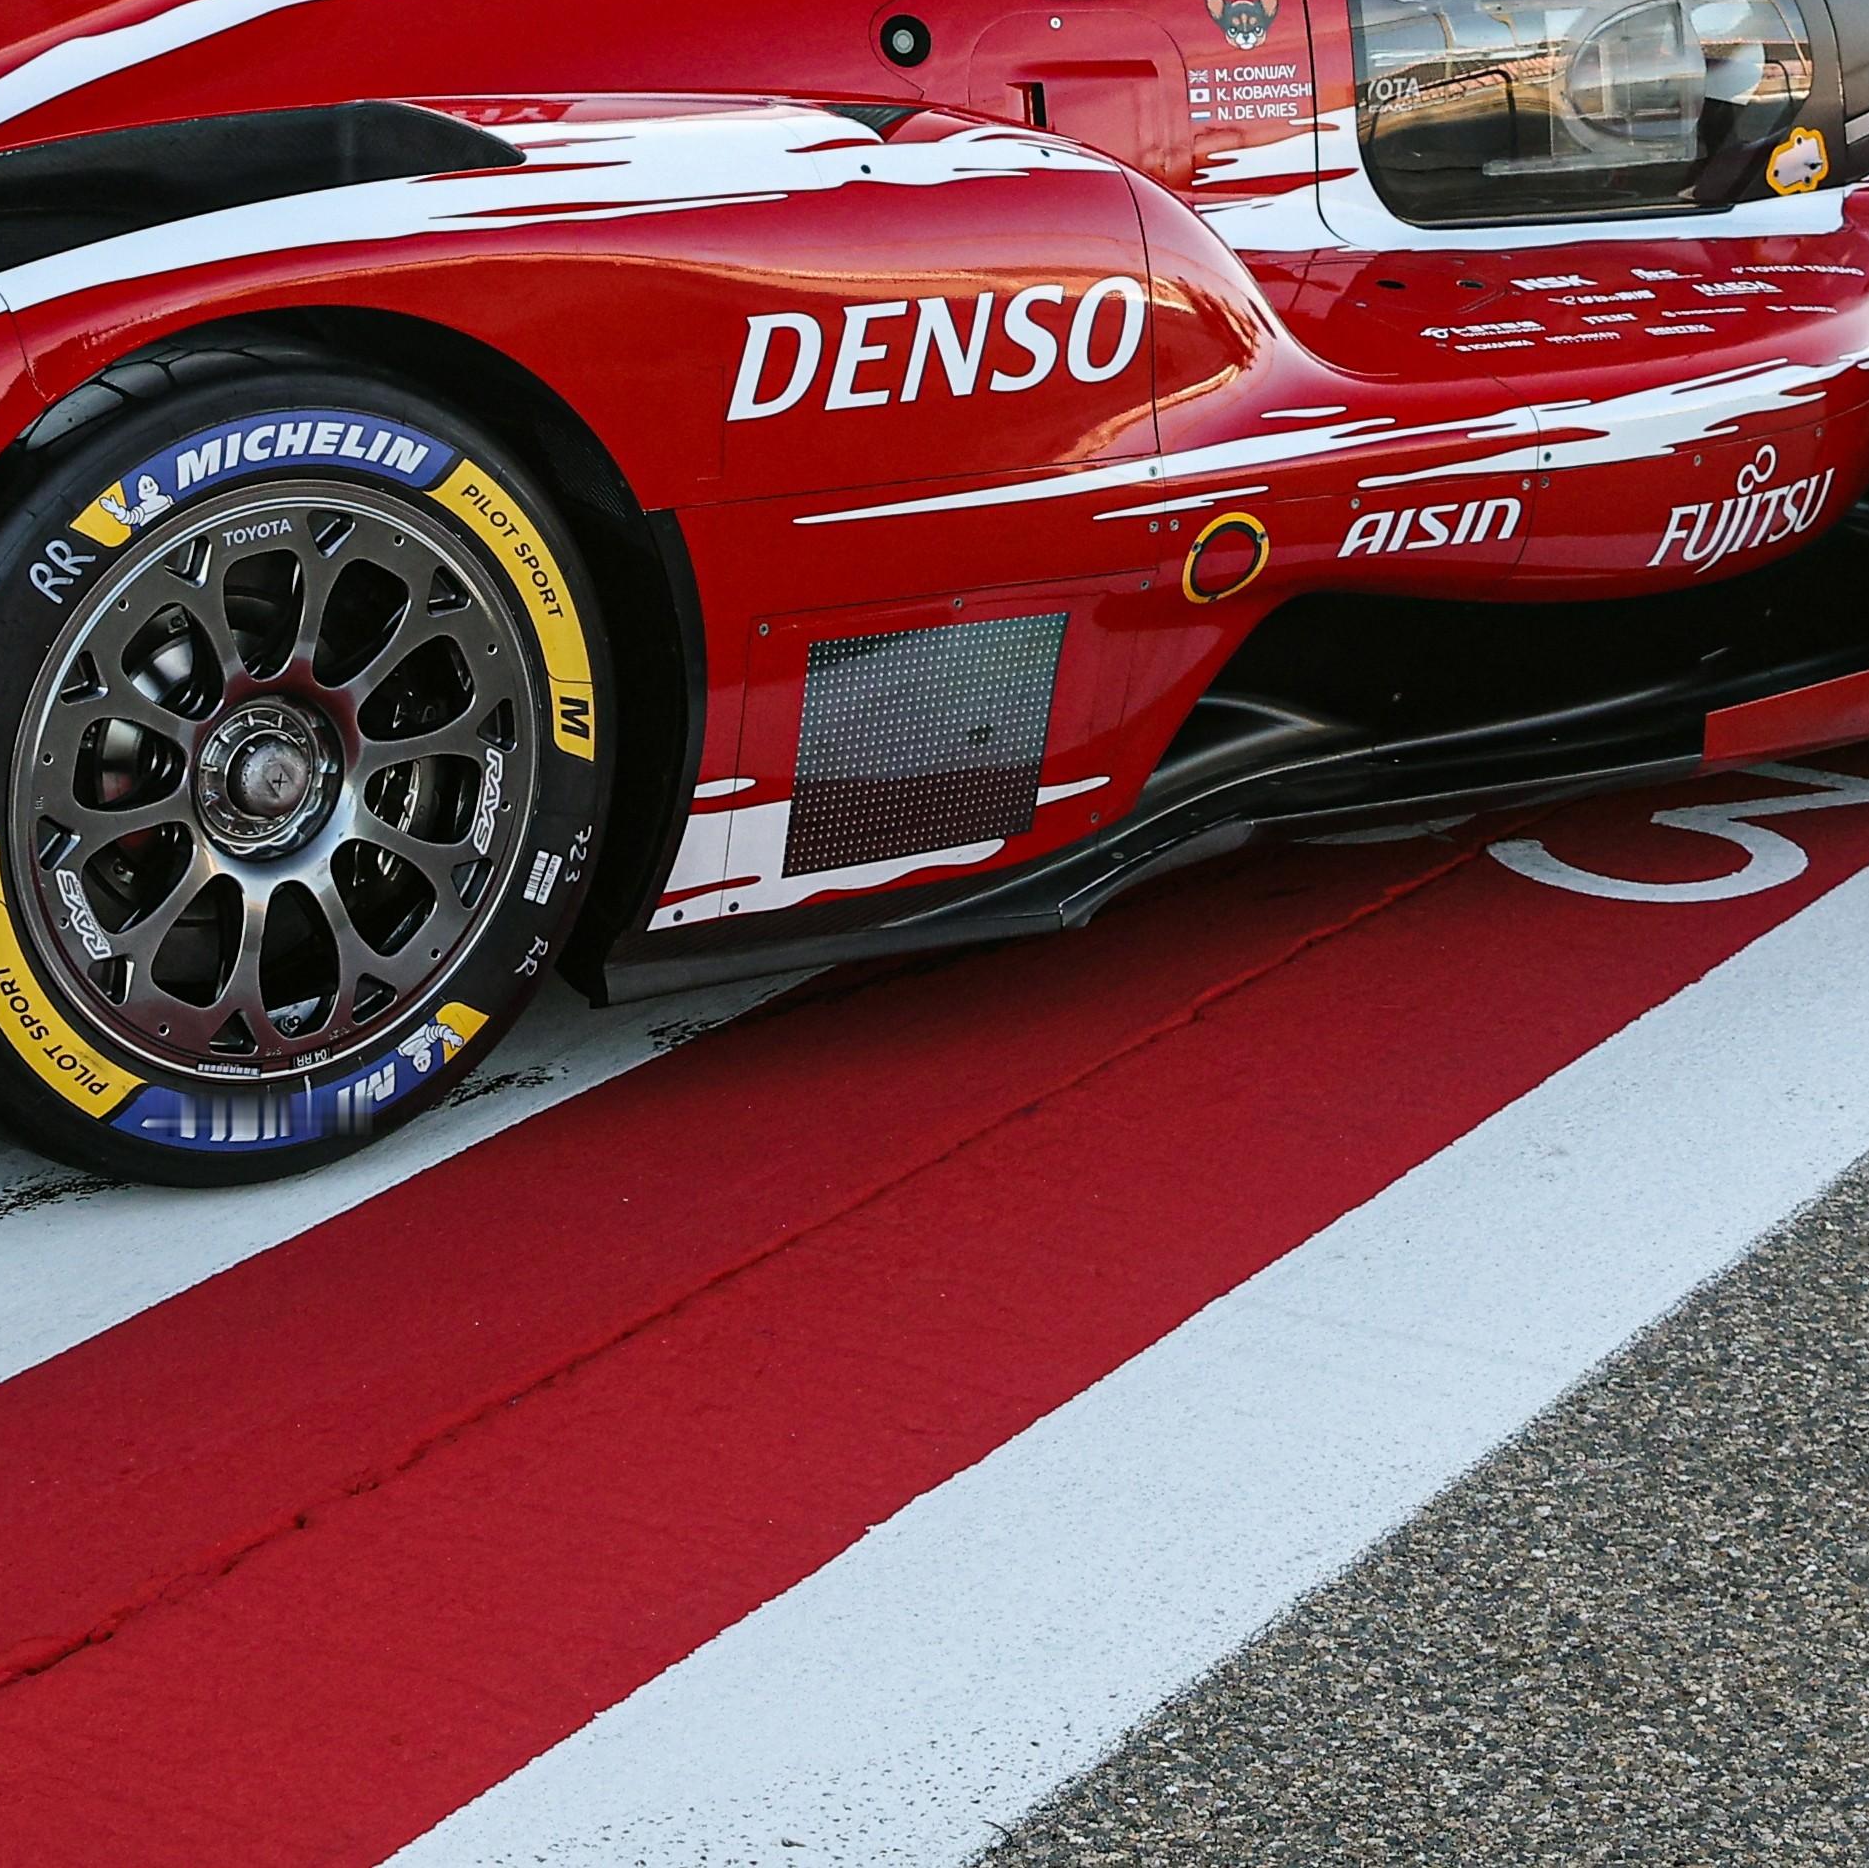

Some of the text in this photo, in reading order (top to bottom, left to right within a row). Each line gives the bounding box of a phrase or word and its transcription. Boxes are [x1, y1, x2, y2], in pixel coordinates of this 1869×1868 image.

[1215, 65, 1297, 82] M. CONWAY
[1216, 83, 1312, 102] K. KOBAYASHI
[1217, 103, 1297, 120] N. DE VRIES
[1510, 275, 1599, 291] NSK
[727, 275, 1146, 422] DENSO
[176, 421, 429, 491] MICHELIN
[222, 518, 292, 547] TOYOTA
[1337, 497, 1523, 557] AISIN
[1646, 466, 1836, 574] FUJITSU
[30, 539, 96, 604] RR
[461, 484, 564, 618] PILOT SPORT
[559, 696, 590, 740] M
[473, 748, 503, 855] RAYS
[56, 869, 112, 961] RAYS
[42, 1044, 109, 1096] PILOT
